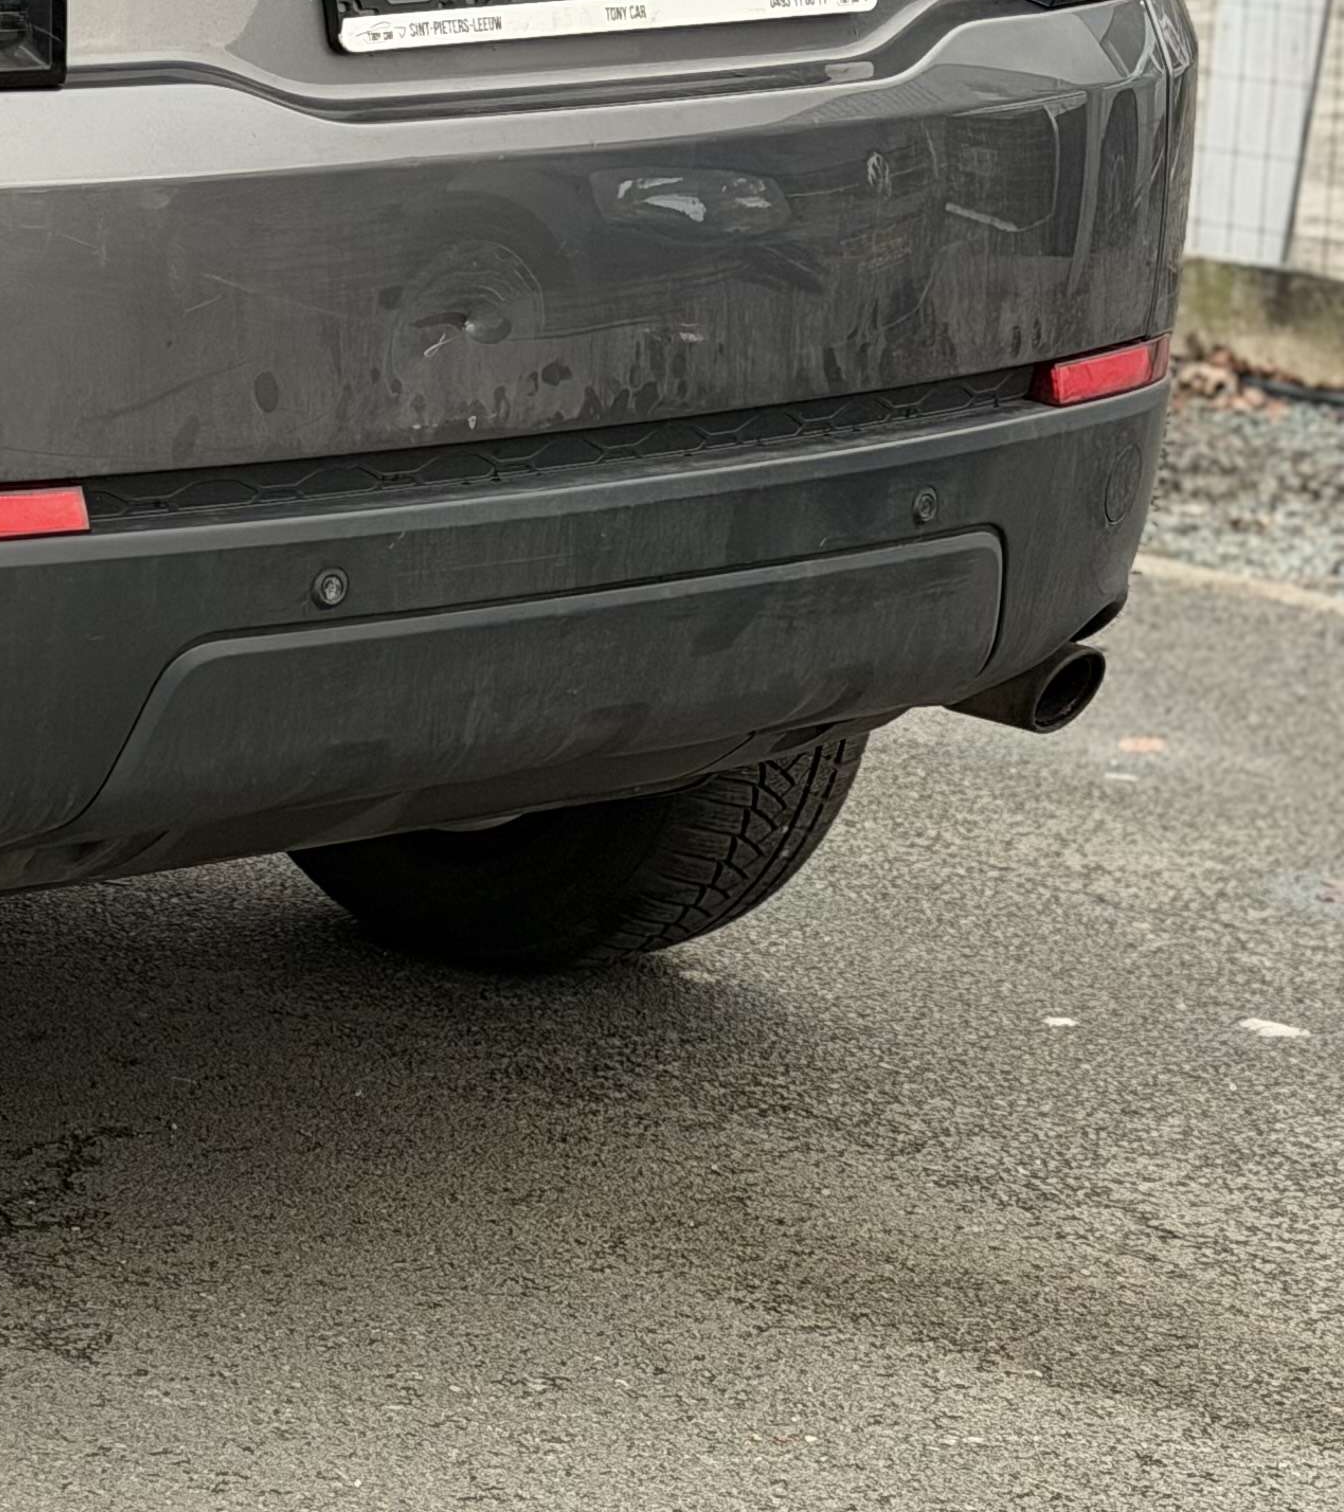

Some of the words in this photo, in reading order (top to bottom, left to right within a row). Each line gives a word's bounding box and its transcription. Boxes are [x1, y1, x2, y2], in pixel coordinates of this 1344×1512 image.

[604, 6, 627, 21] TONY
[629, 4, 647, 19] CAR
[408, 15, 503, 38] SINT-PIETERS-LEEUW
